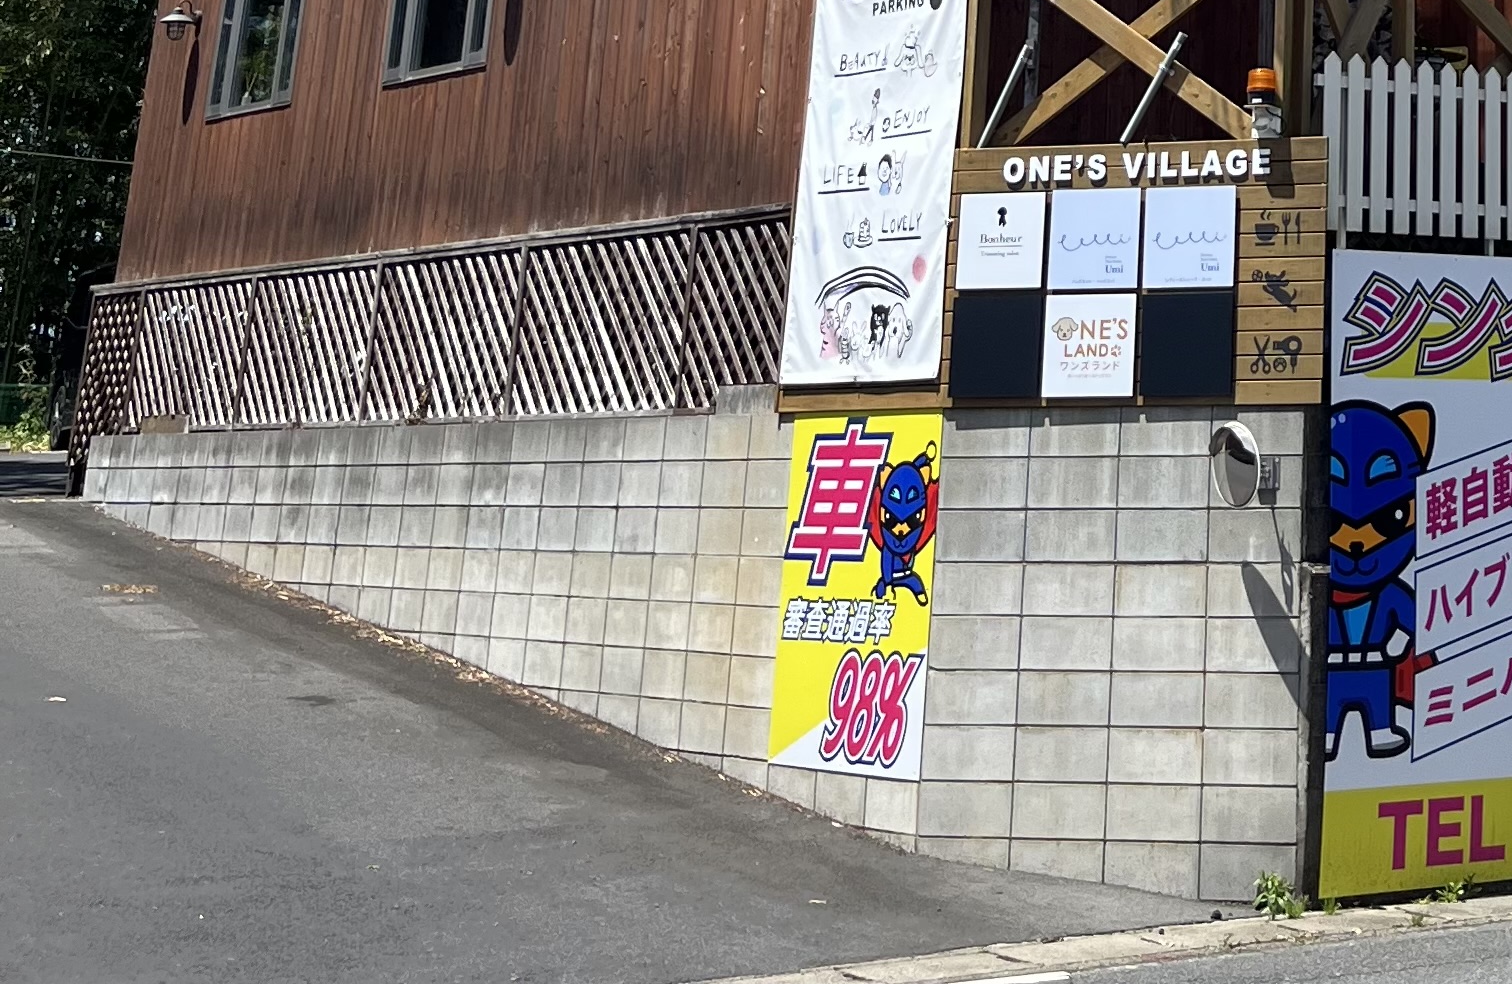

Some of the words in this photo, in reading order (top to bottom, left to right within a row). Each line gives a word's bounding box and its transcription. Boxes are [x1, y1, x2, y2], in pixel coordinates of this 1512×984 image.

[823, 164, 855, 186] LIFE
[1003, 154, 1107, 184] ONE'S
[1122, 148, 1271, 179] VILLAGE
[881, 211, 922, 234] LOVELY
[980, 233, 1022, 244] Bonheur
[1105, 264, 1124, 274] Umi
[1200, 261, 1220, 272] Umi
[1064, 343, 1109, 358] LAND
[1060, 360, 1121, 372] ワンズランド
[786, 420, 892, 584] 車
[781, 597, 897, 645] 審査通過率
[820, 648, 925, 768] 98%
[1378, 795, 1506, 871] TEL
